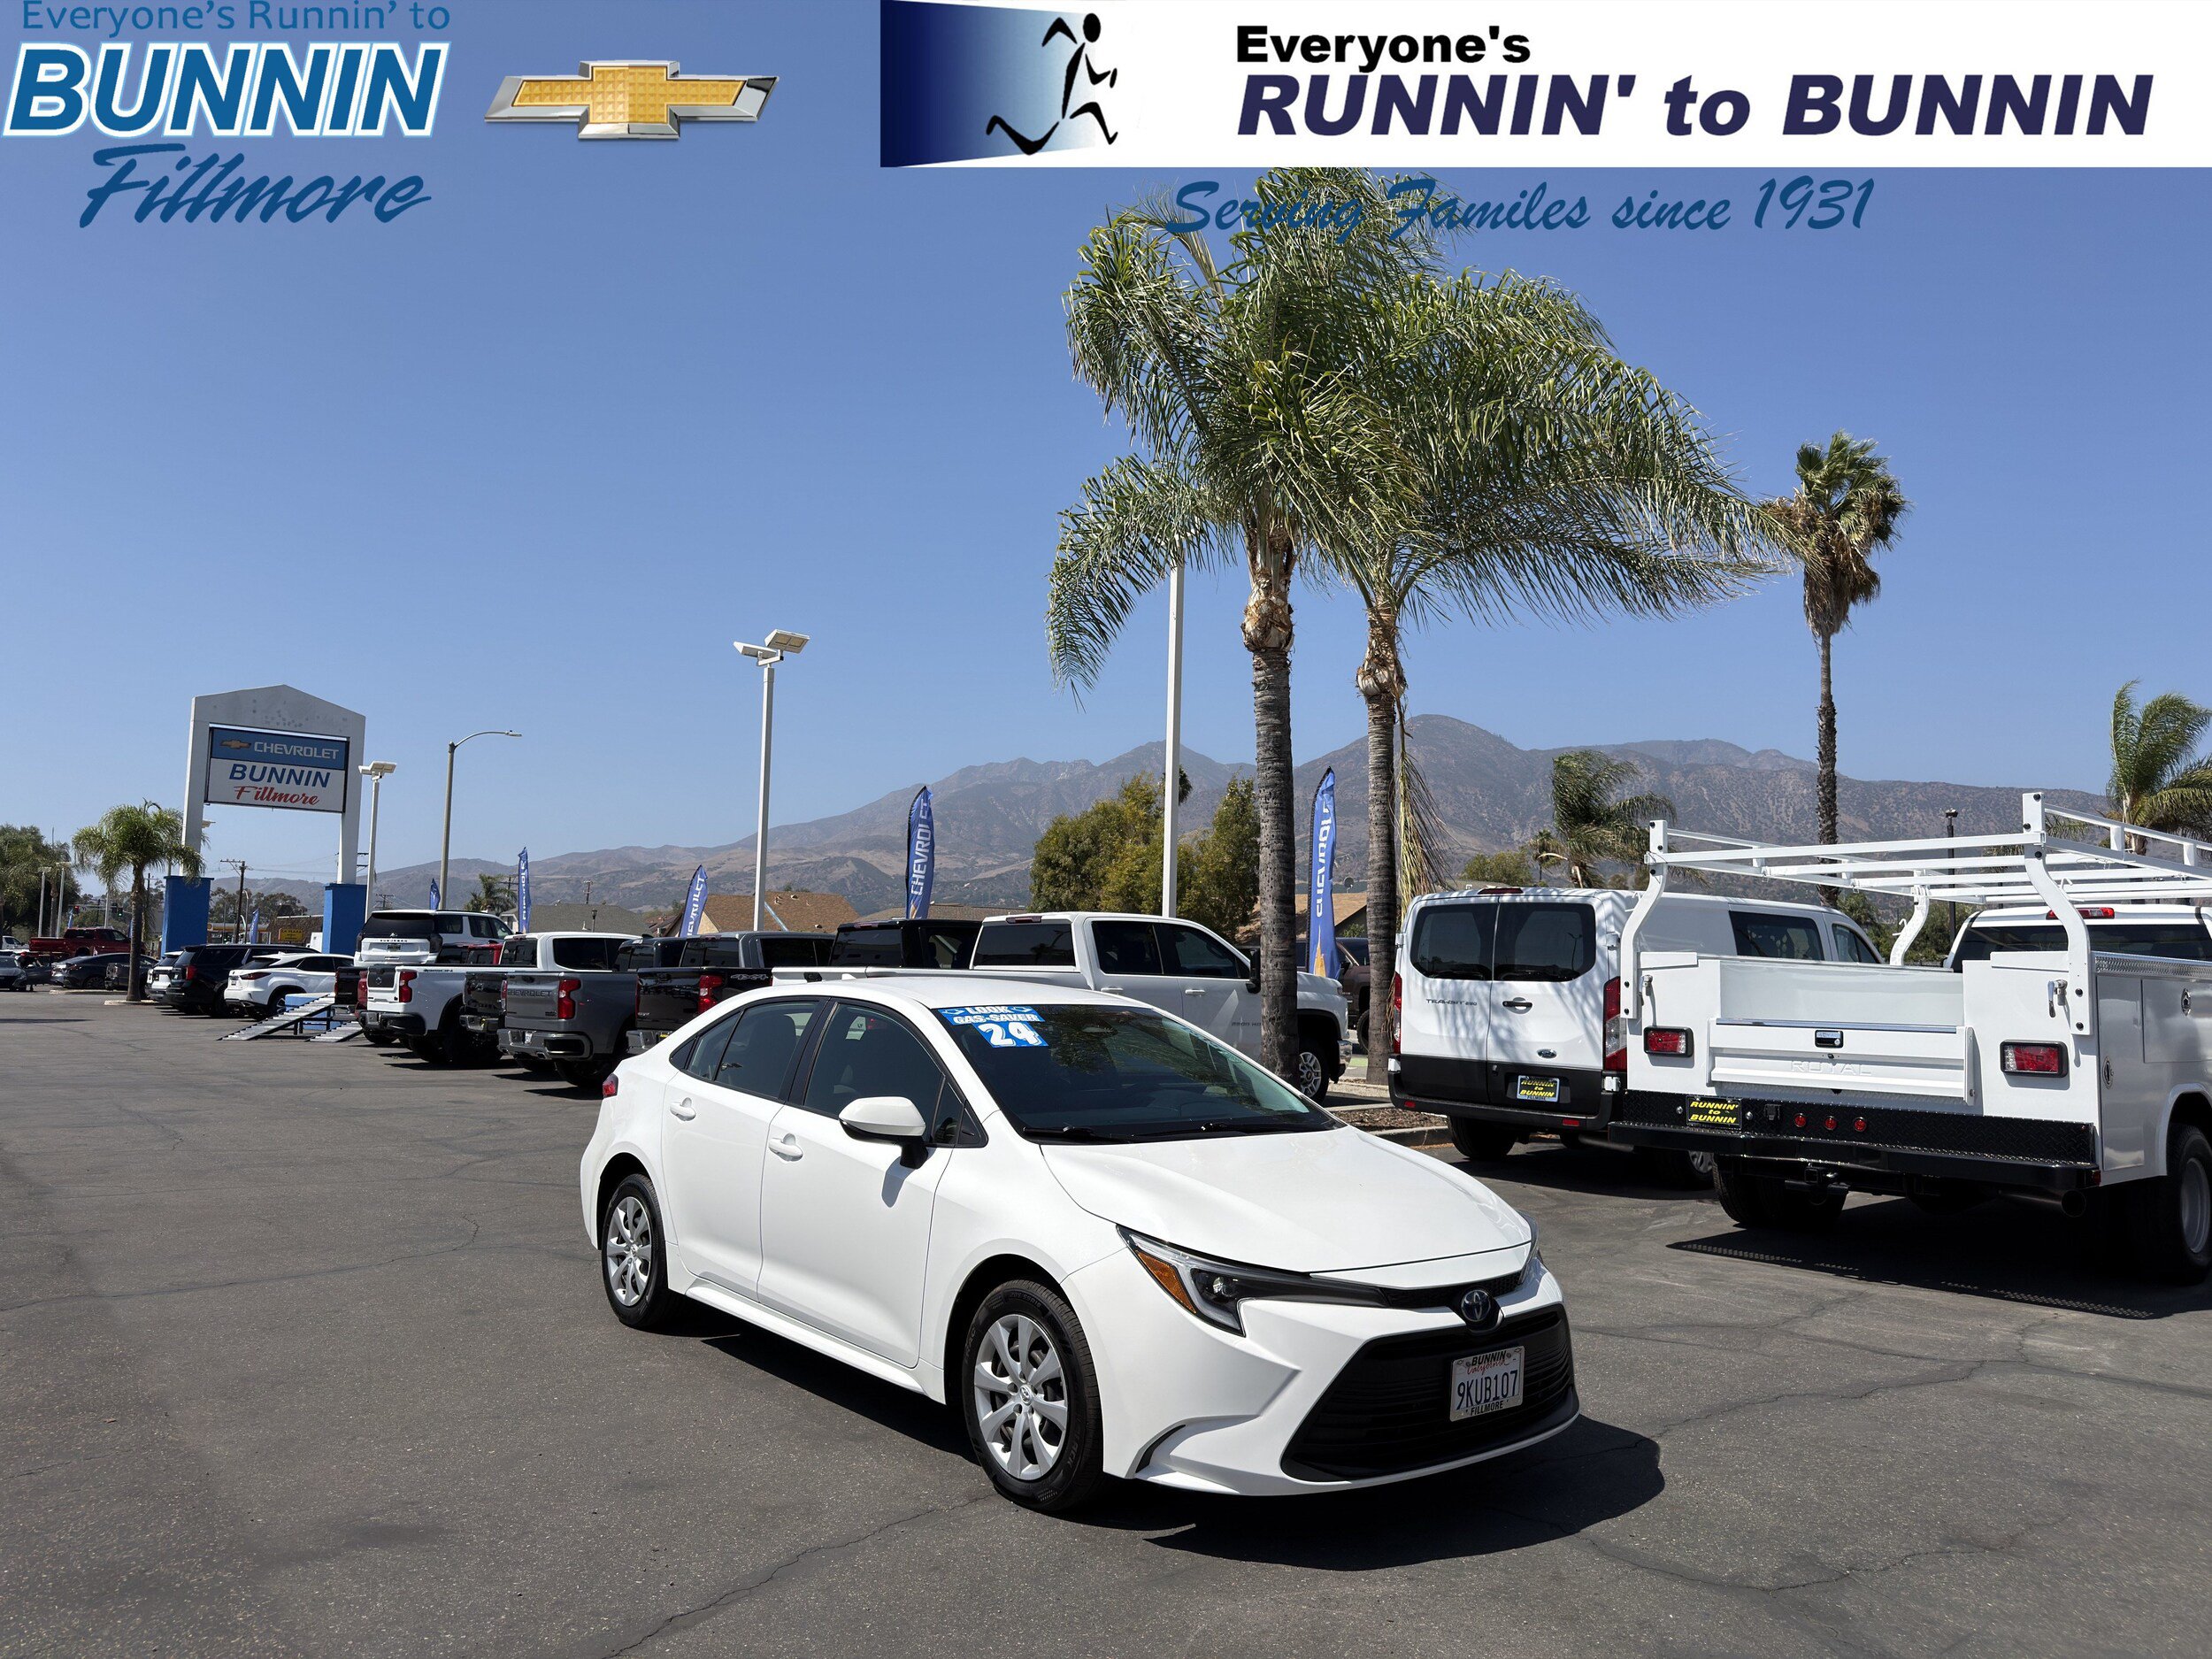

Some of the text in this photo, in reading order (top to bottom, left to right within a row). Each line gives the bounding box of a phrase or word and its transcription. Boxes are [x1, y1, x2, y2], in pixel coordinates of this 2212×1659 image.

[254, 741, 339, 760] CHEVROLET
[228, 763, 331, 788] BUNNIN
[233, 786, 320, 806] Fillmore
[964, 1005, 1014, 1014] LOOK
[953, 1013, 1040, 1024] GAS-SAVER
[978, 1021, 1042, 1046] 24
[1790, 1060, 1872, 1076] ROYAL
[1690, 1101, 1739, 1110] RUNNIN'
[1690, 1114, 1737, 1124] BUNNIN
[1471, 1350, 1507, 1366] BUNNIN
[1456, 1370, 1518, 1410] 9KUB107
[1470, 1400, 1504, 1416] FILLMORE
